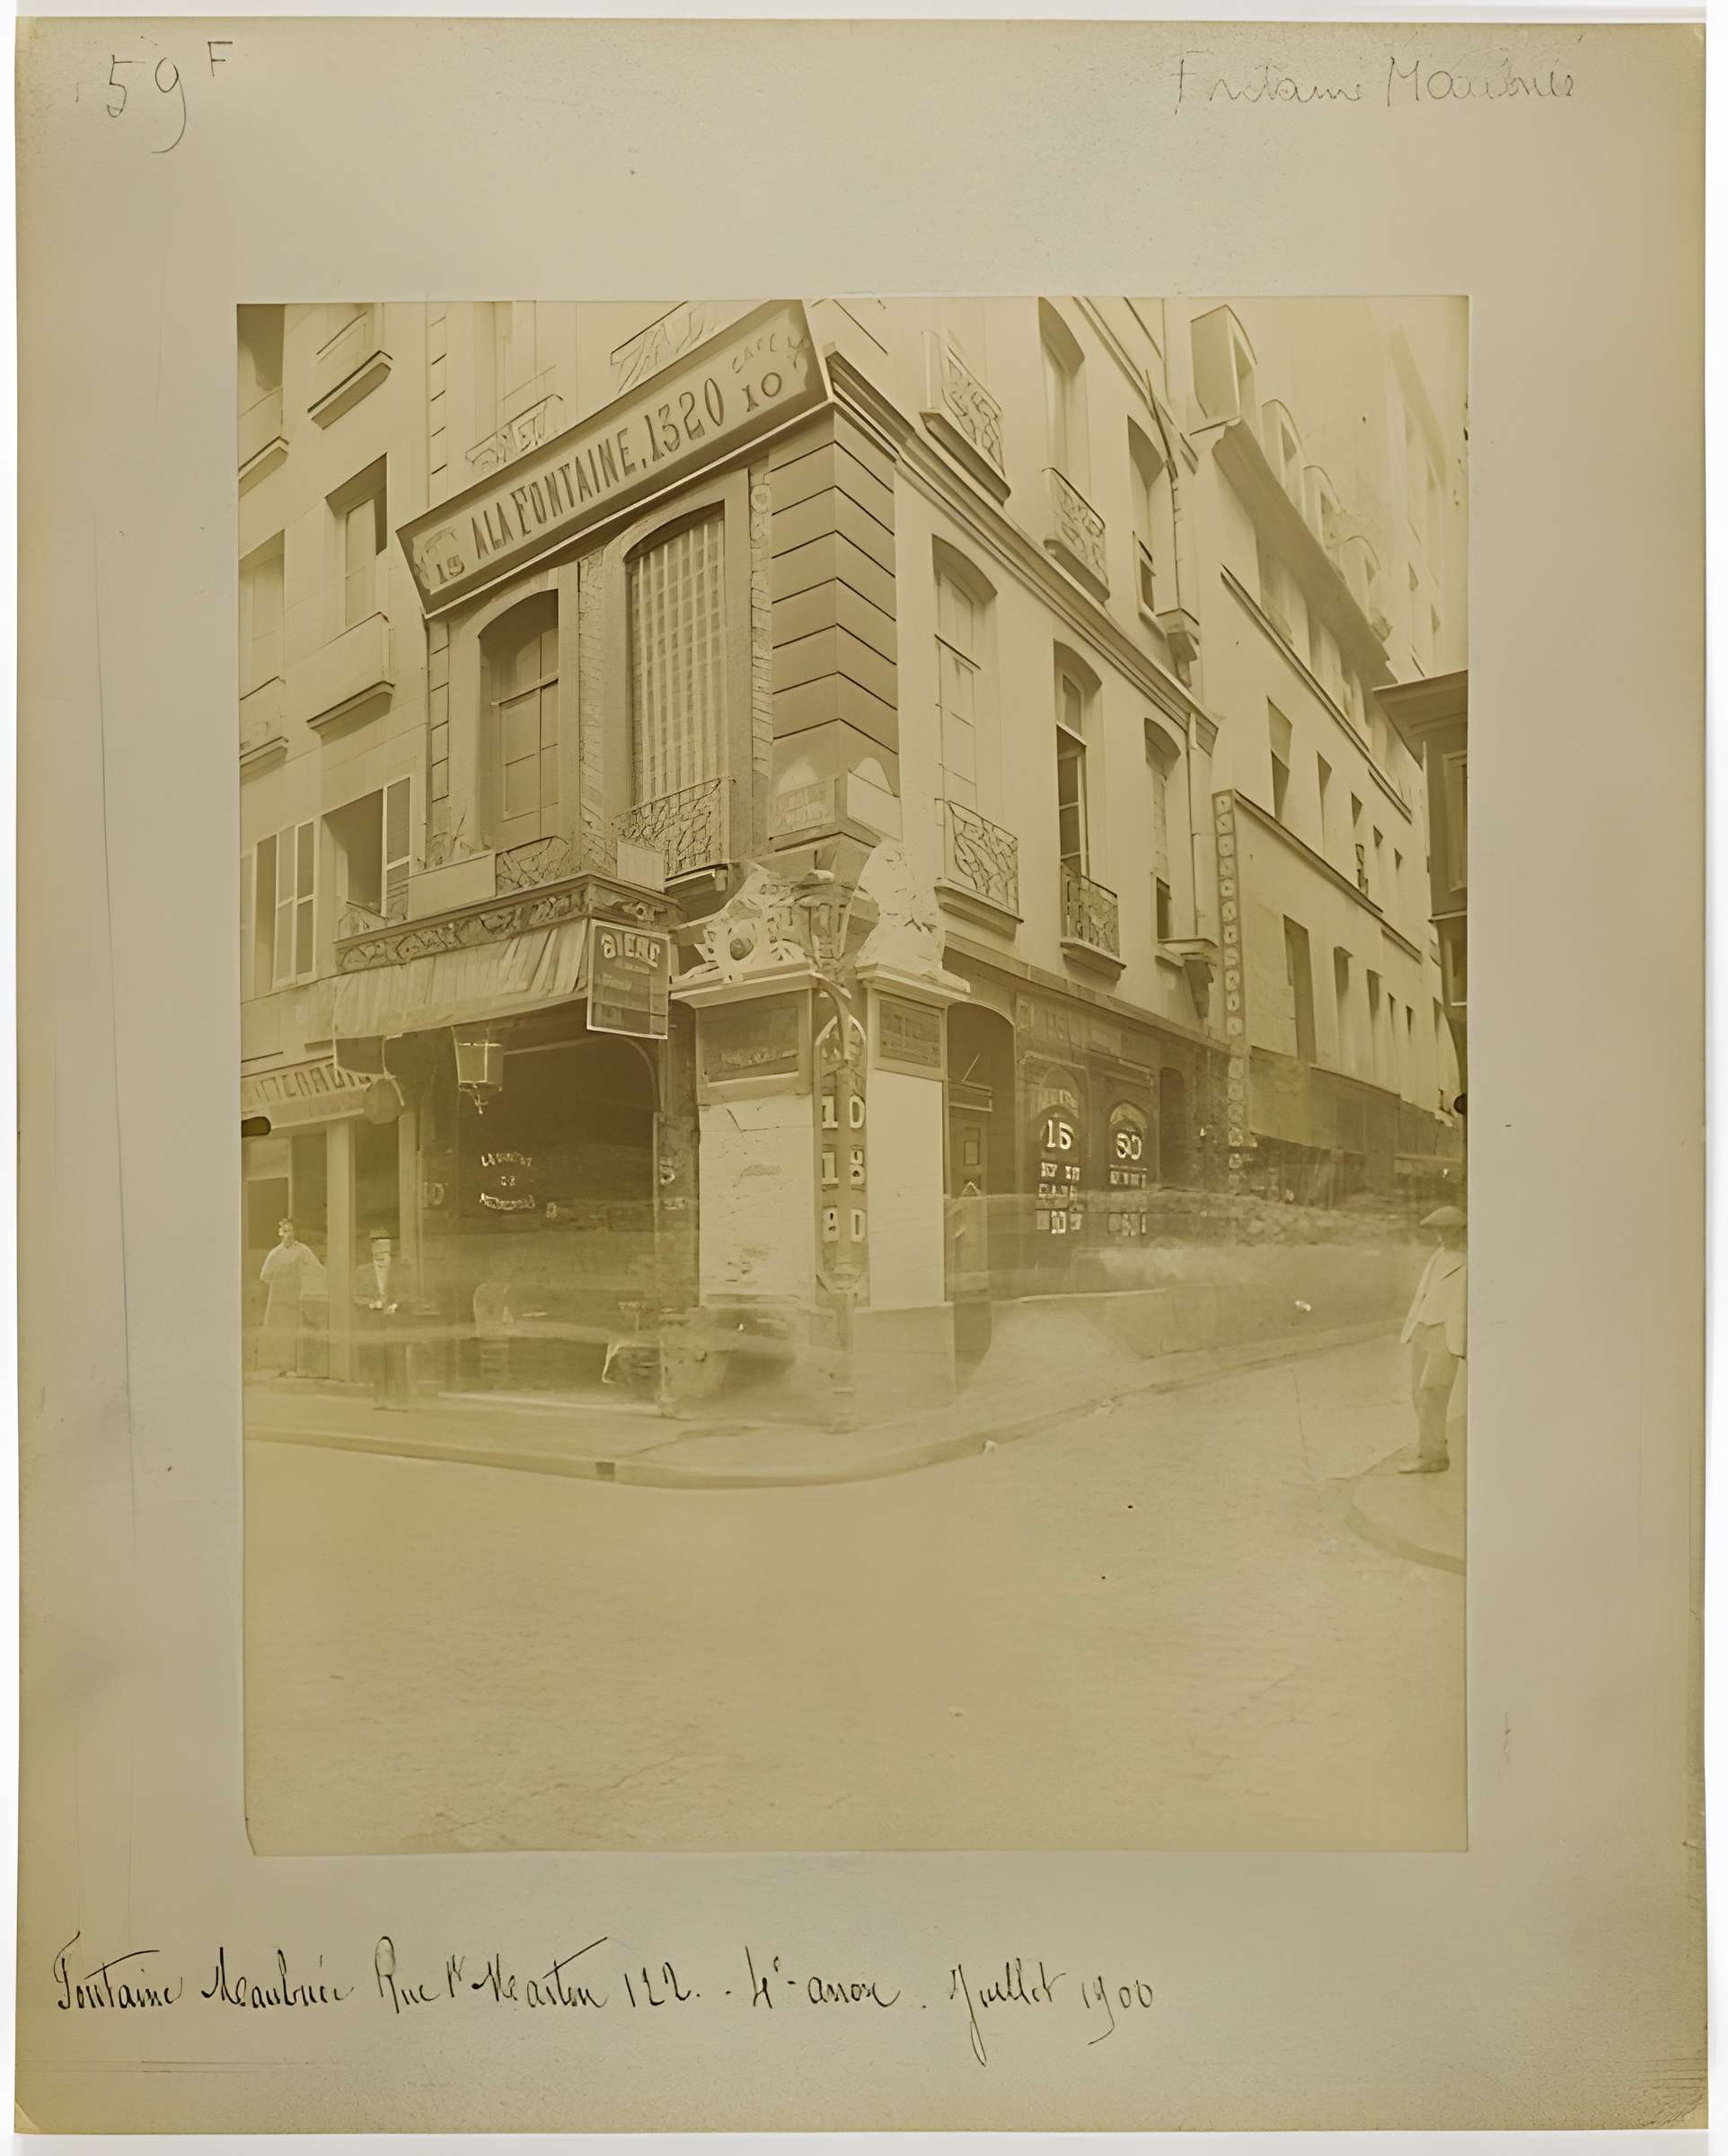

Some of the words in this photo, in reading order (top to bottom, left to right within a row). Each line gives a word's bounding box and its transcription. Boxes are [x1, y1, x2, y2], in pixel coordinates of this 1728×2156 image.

[644, 377, 725, 462] 1320
[52, 1930, 184, 2010] Fontaine
[375, 1936, 441, 2014] Rue
[1080, 1975, 1153, 2046] 1900
